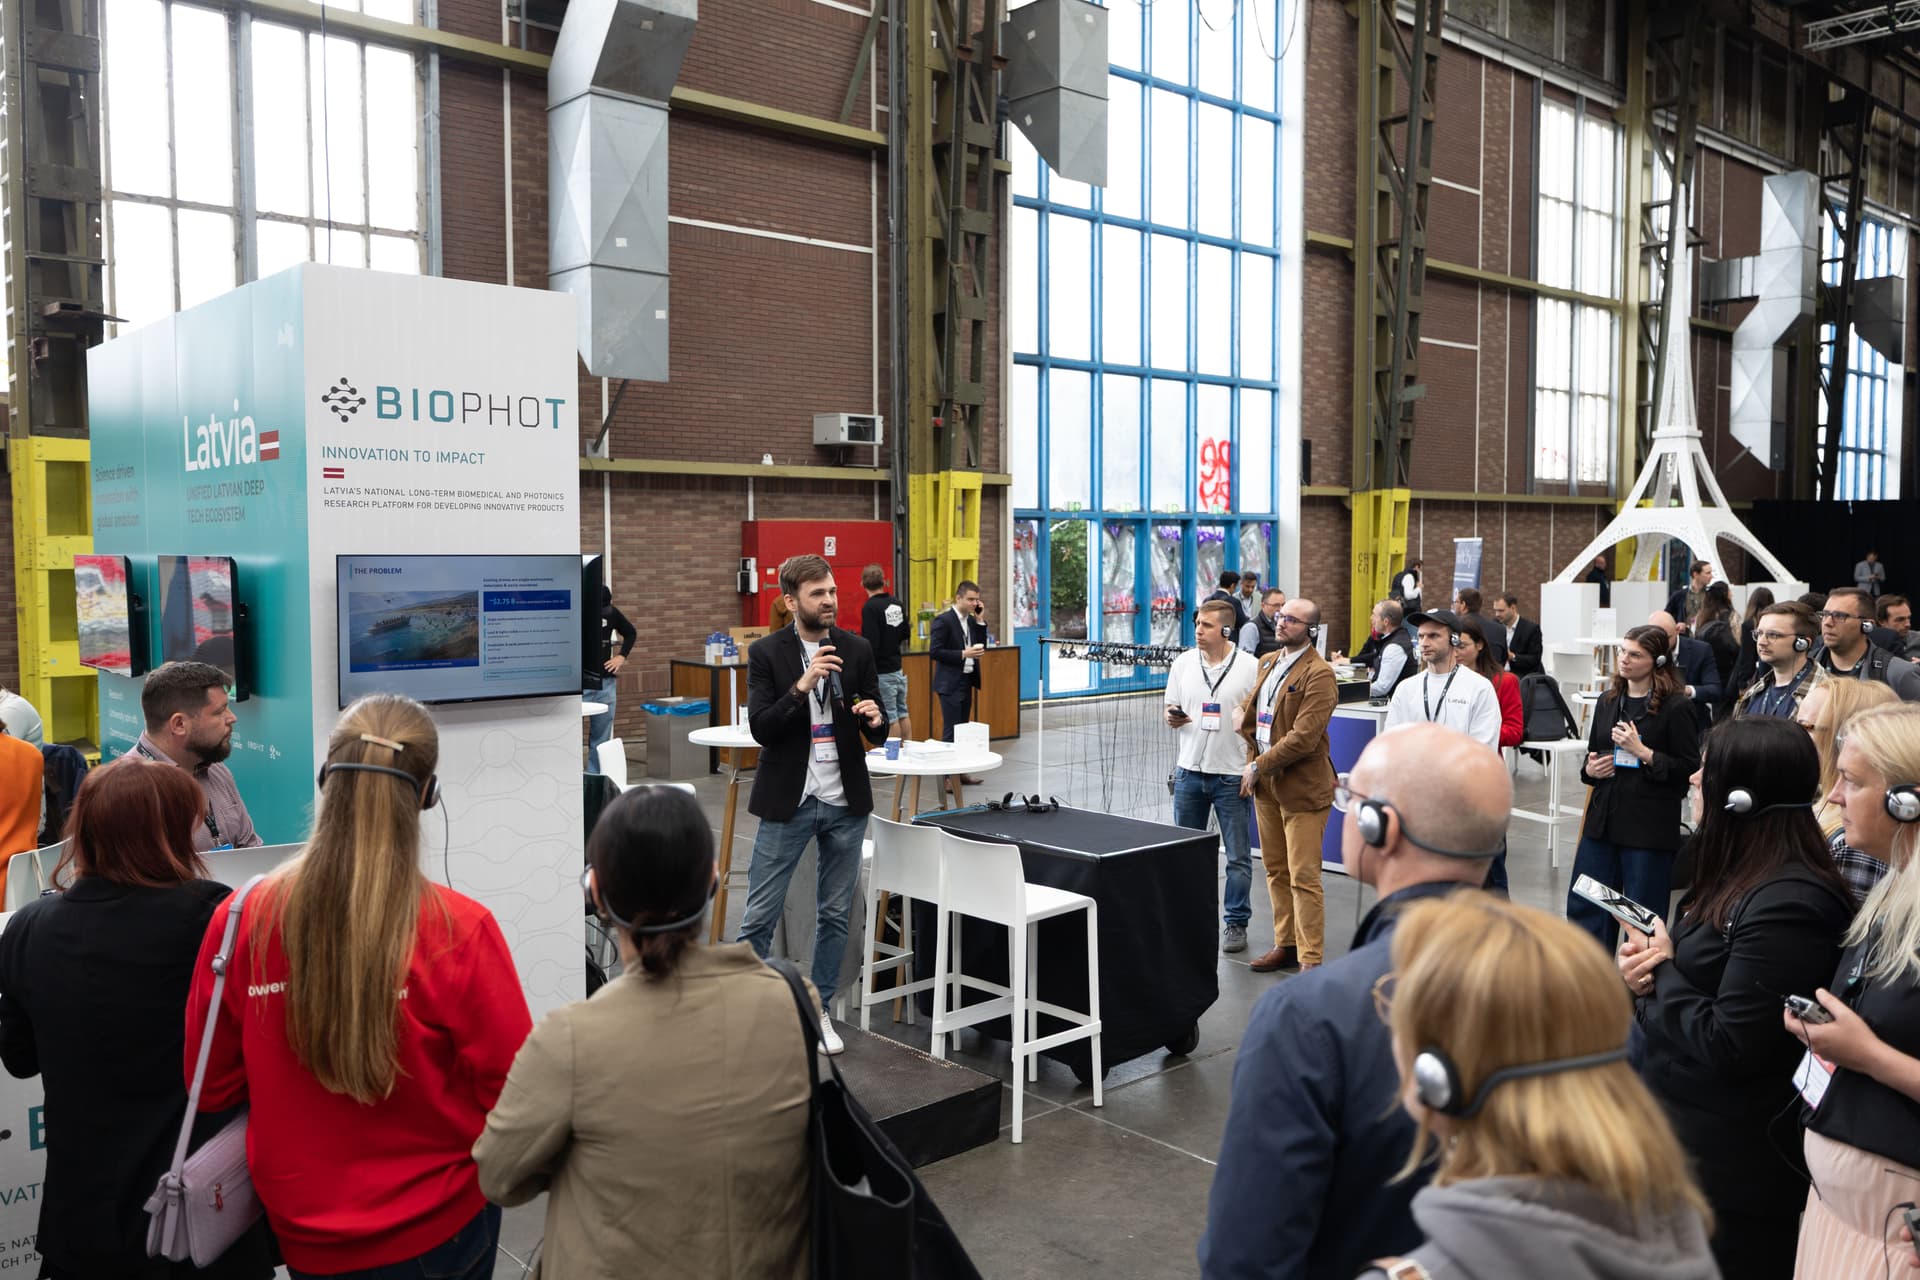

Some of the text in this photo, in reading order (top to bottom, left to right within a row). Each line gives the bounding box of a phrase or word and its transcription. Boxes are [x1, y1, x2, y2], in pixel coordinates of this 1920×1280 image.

[376, 385, 566, 429] BIOPHOT
[183, 397, 257, 472] Latvia
[321, 446, 486, 465] INNOVATION TO IMPACT
[213, 480, 243, 498] LATVIAN
[244, 479, 265, 496] DEEP
[323, 487, 565, 501] LATVIA'S NATIONAL LONG-TERM BIOMEDICAL AND PHOTONICS
[186, 506, 246, 523] TECH ECOSYSTEM
[324, 499, 565, 513] RESEARCH PLATFORM FOR DEVELOPING INNOVATIVE PRODUCTS
[354, 567, 402, 575] THE PROBLEM
[0, 1182, 44, 1206] VAT
